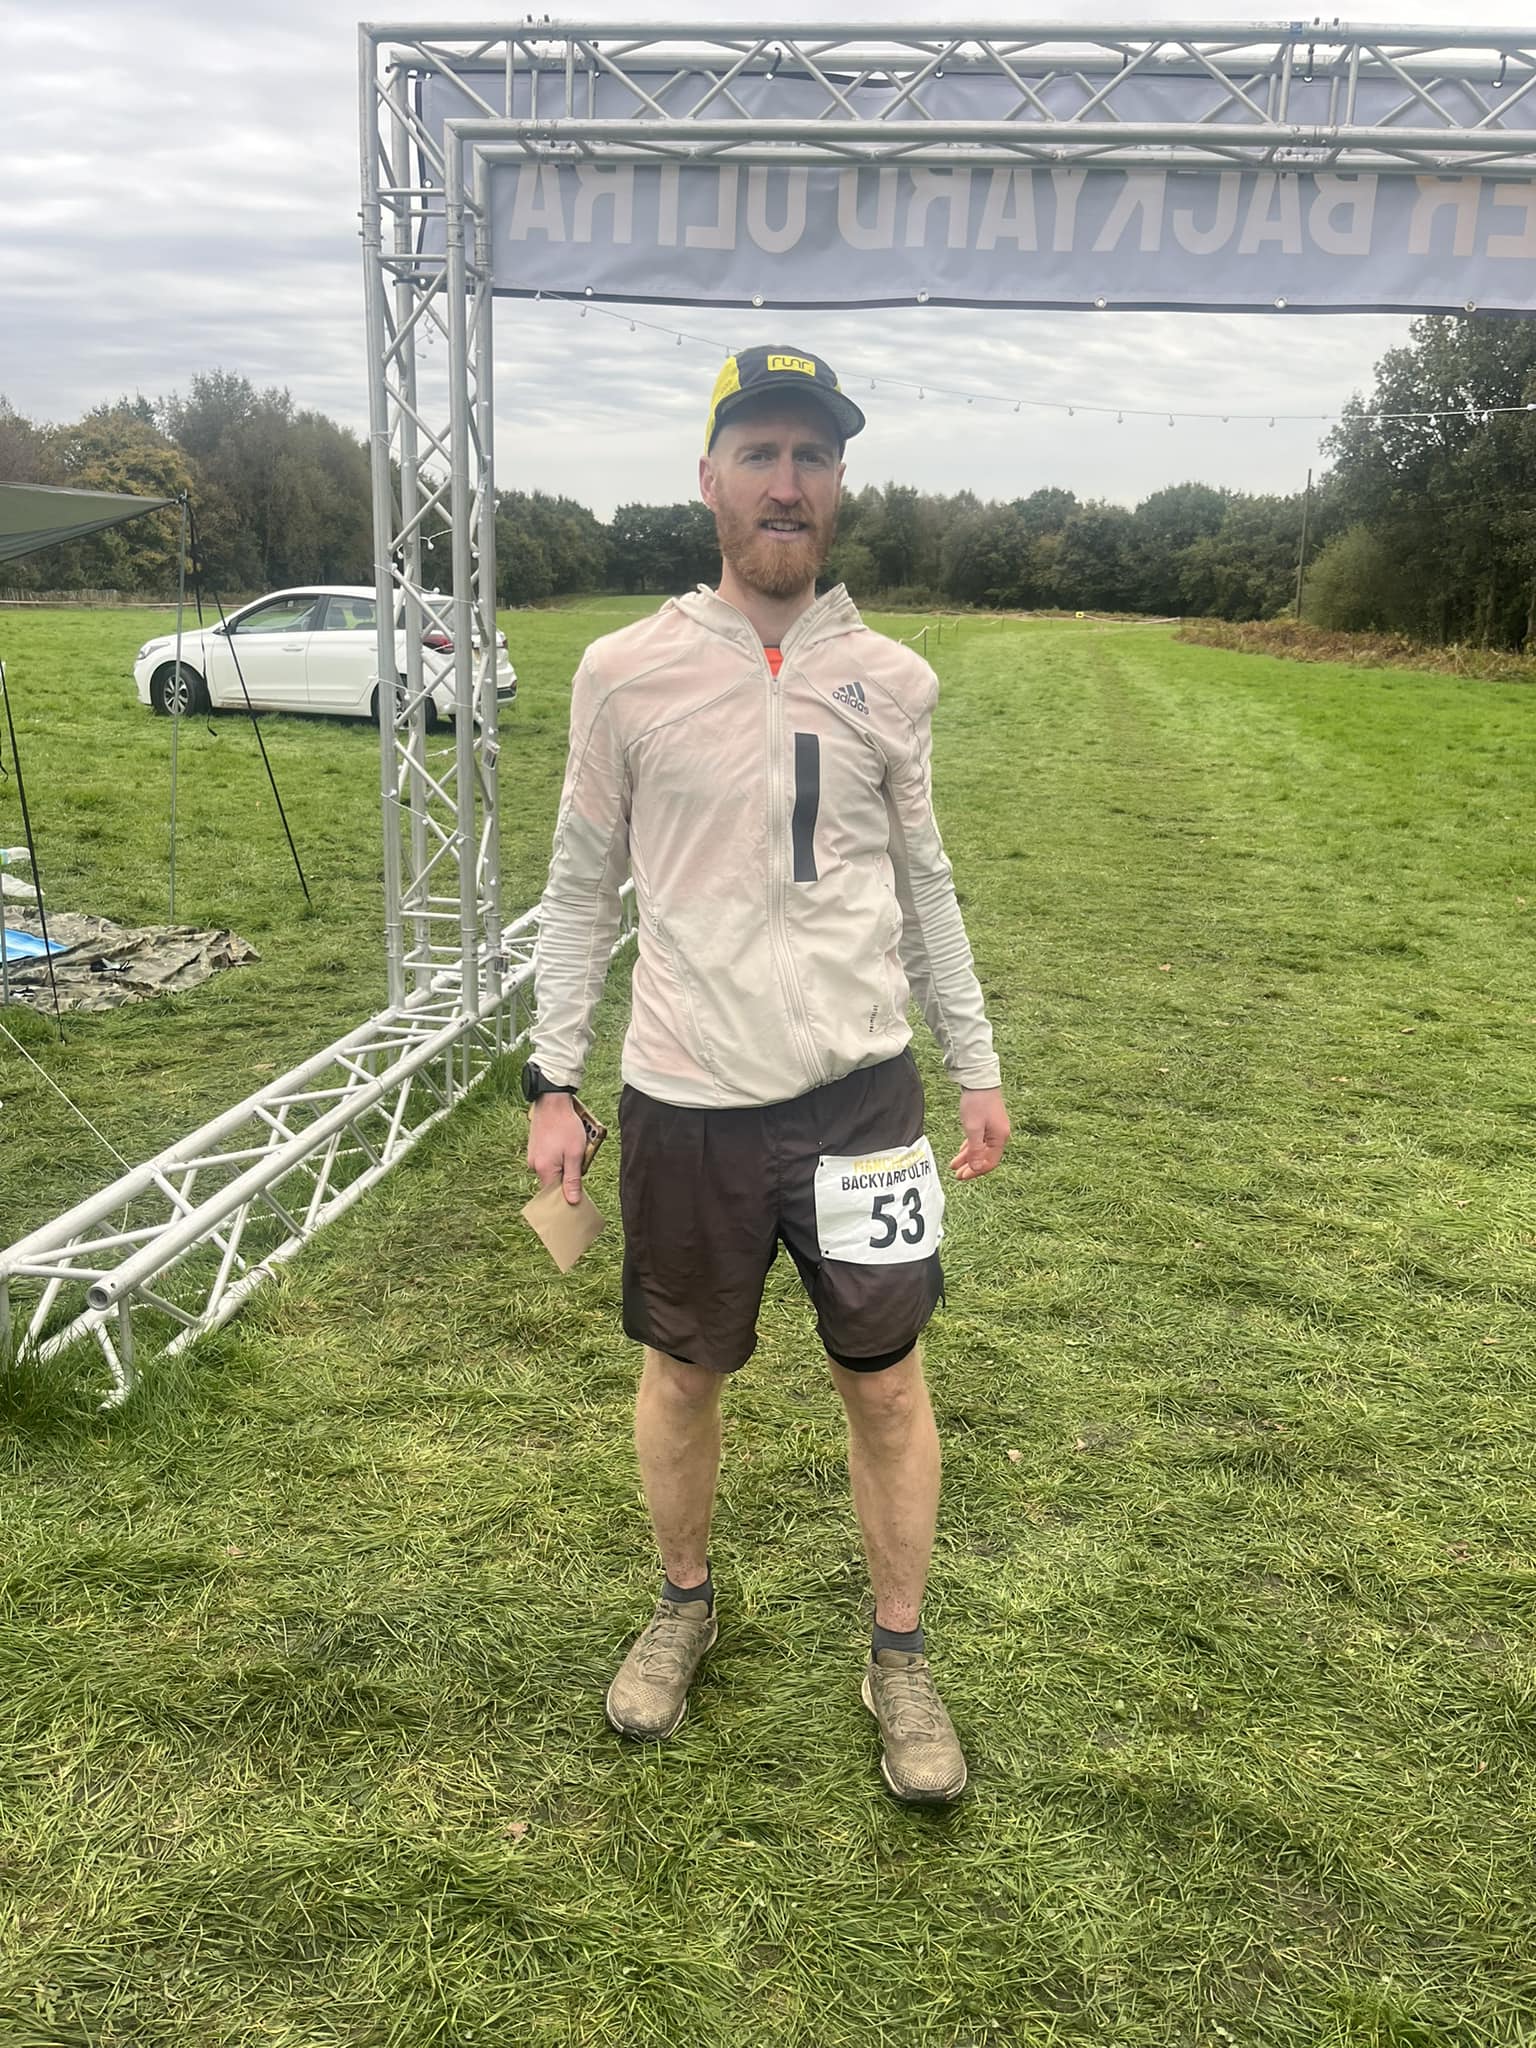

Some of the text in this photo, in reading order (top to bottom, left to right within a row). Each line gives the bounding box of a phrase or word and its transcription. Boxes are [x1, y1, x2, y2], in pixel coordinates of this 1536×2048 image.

[832, 691, 870, 715] adidas
[841, 1169, 907, 1191] BACKYARD
[869, 1187, 926, 1249] 53
